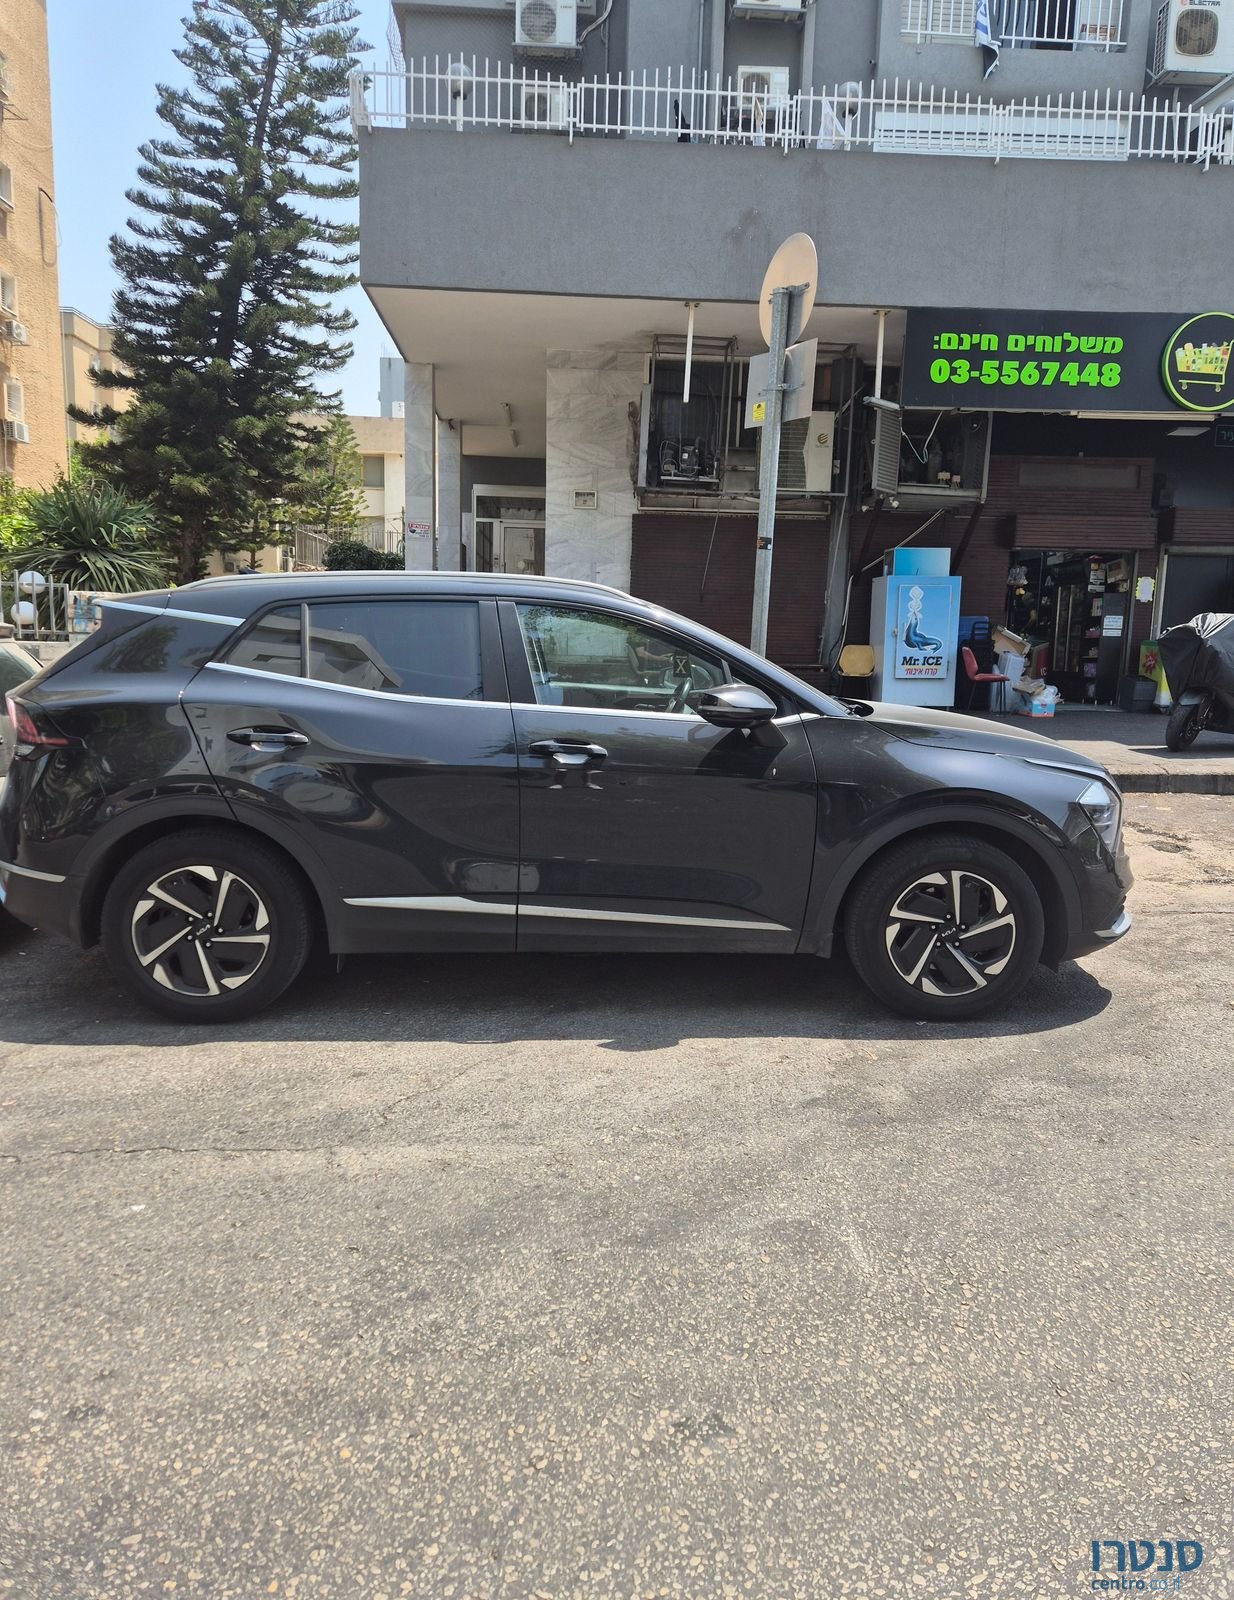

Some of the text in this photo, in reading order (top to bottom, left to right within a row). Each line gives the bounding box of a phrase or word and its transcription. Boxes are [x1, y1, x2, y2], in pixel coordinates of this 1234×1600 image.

[933, 332, 1124, 354] משלוחים חינם:
[929, 358, 1122, 388] 03-5567448
[901, 656, 943, 666] Mr. ICE
